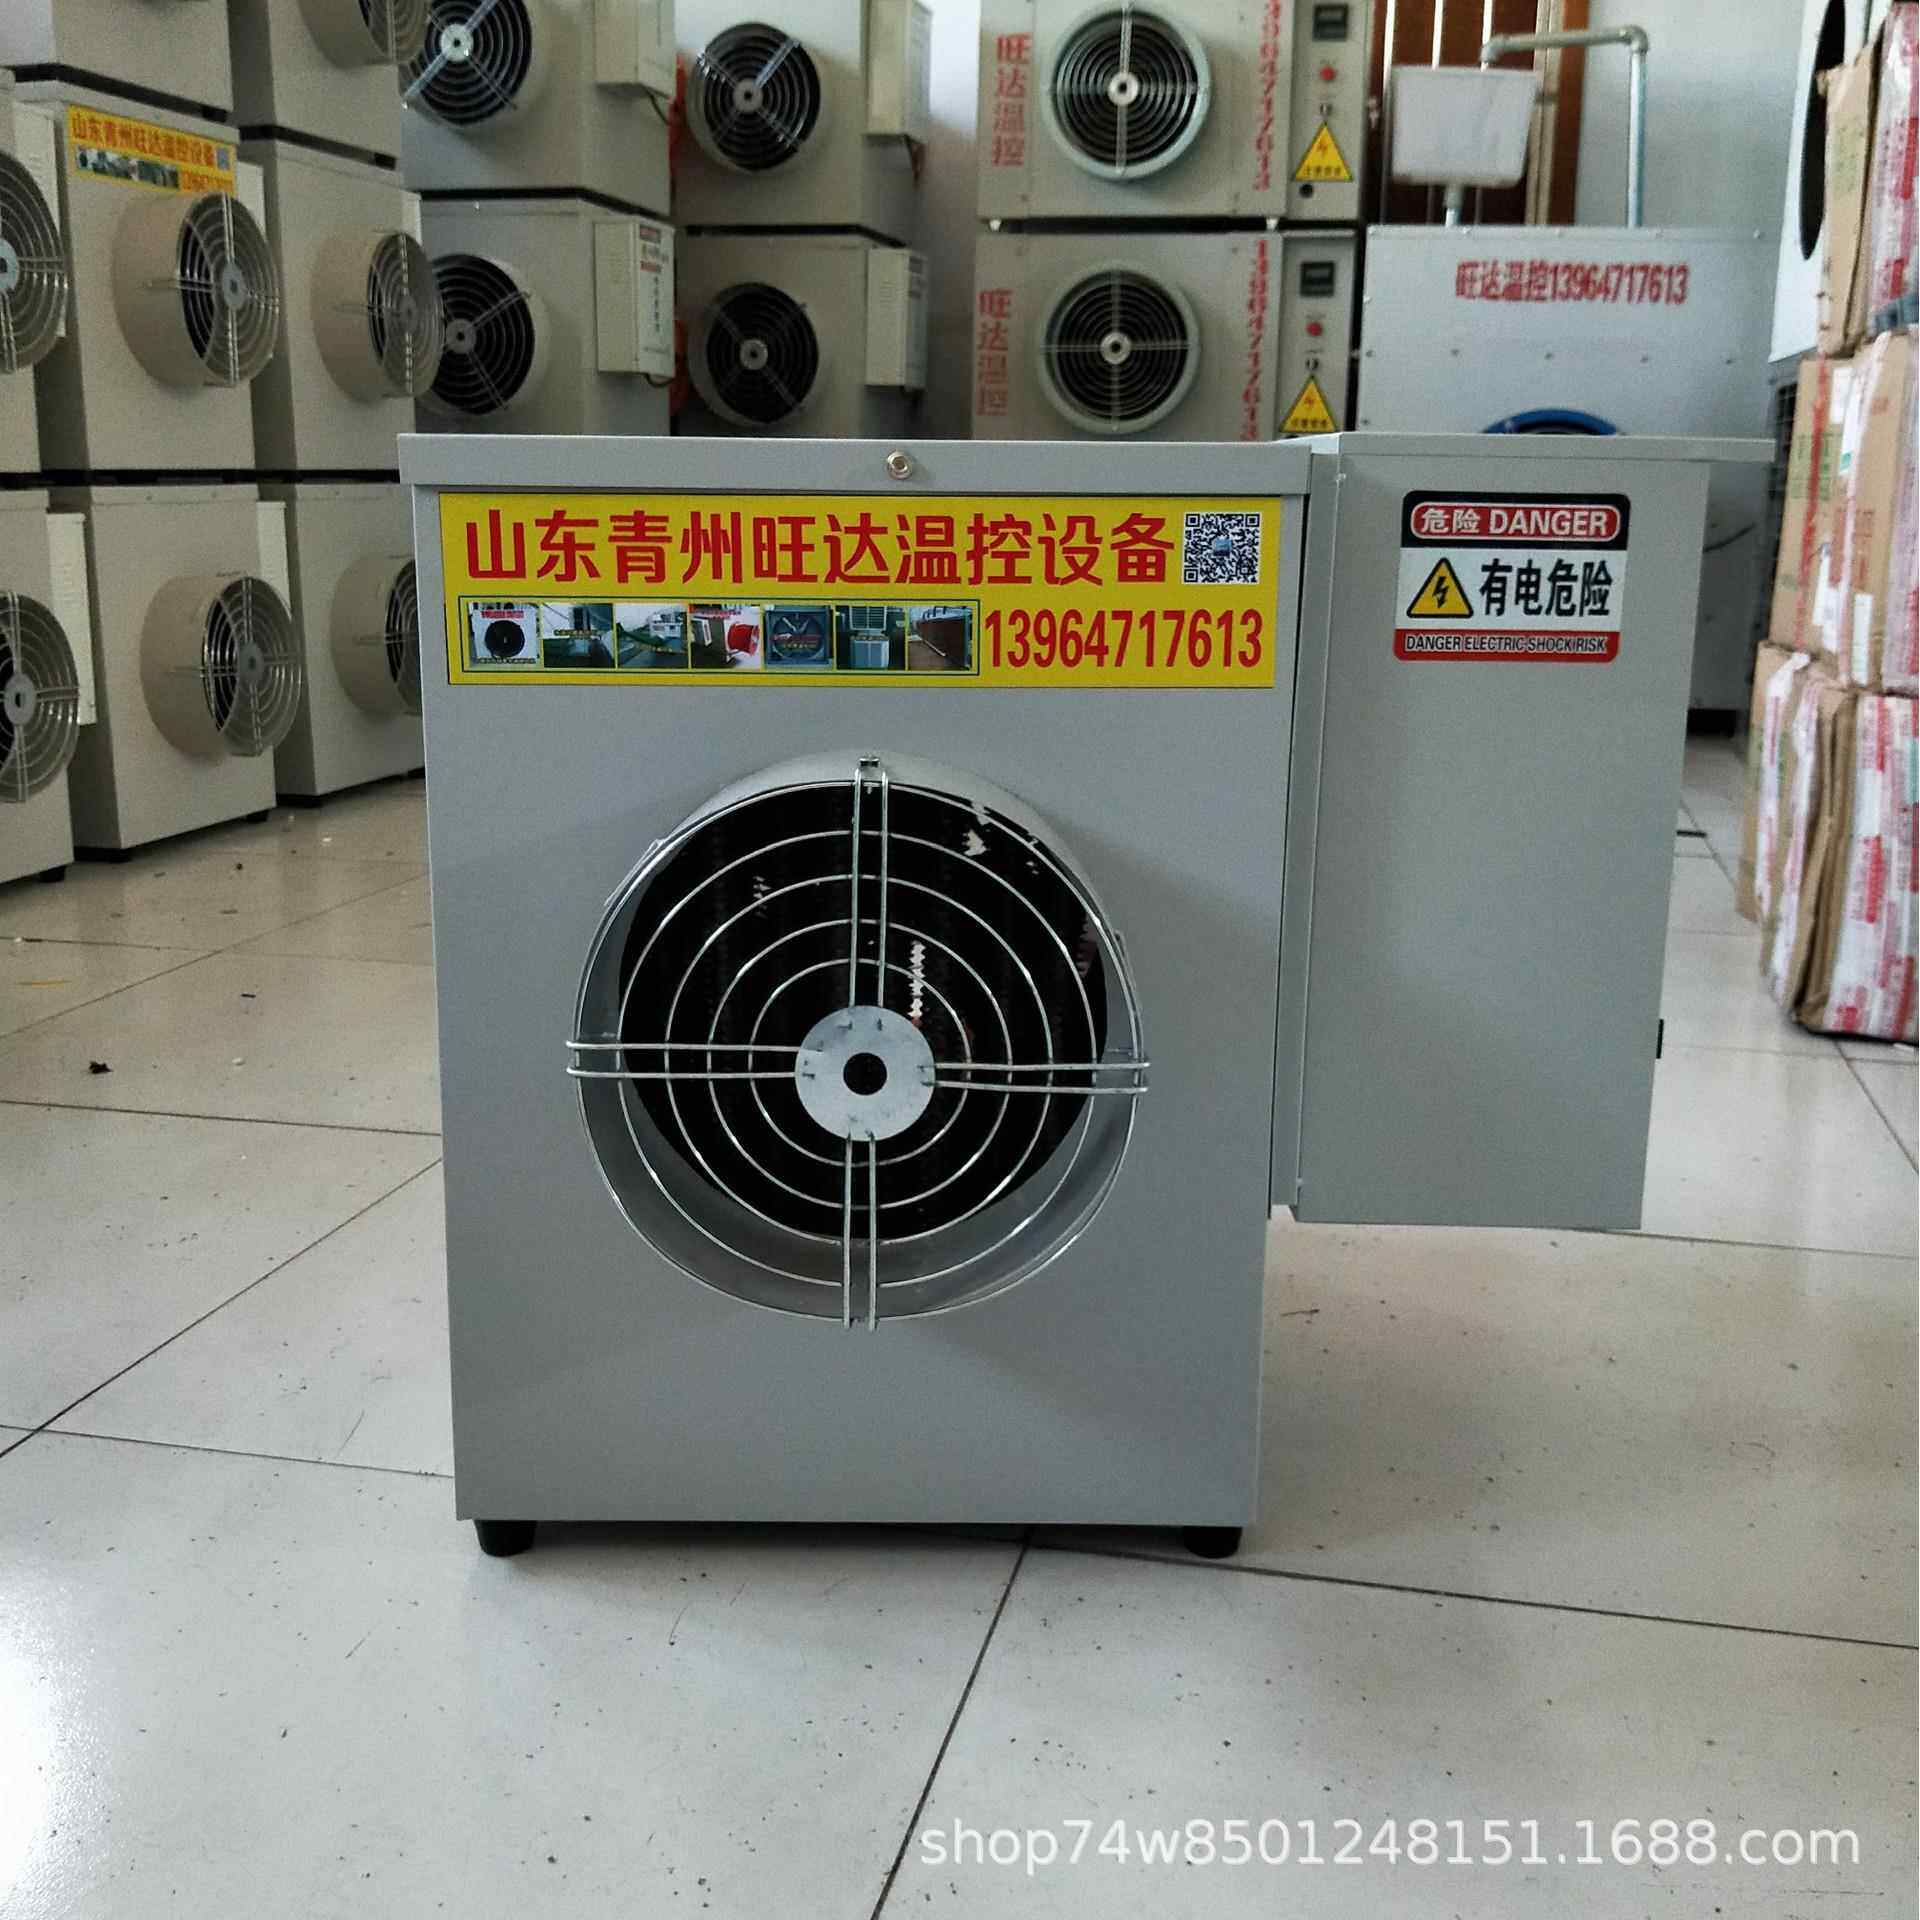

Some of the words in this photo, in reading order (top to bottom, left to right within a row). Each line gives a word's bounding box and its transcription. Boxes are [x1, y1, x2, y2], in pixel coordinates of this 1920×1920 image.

[466, 509, 1175, 587] 山东青州旺达温控设备
[1421, 508, 1480, 533] 危险
[1489, 510, 1608, 536] DANGER
[1479, 557, 1613, 617] 有电危险
[985, 608, 1264, 669] 13964717613
[1406, 635, 1462, 651] DANGER
[1464, 636, 1528, 652] ELECTRIC
[1528, 637, 1573, 652] SHOCK
[1575, 637, 1607, 653] RISK
